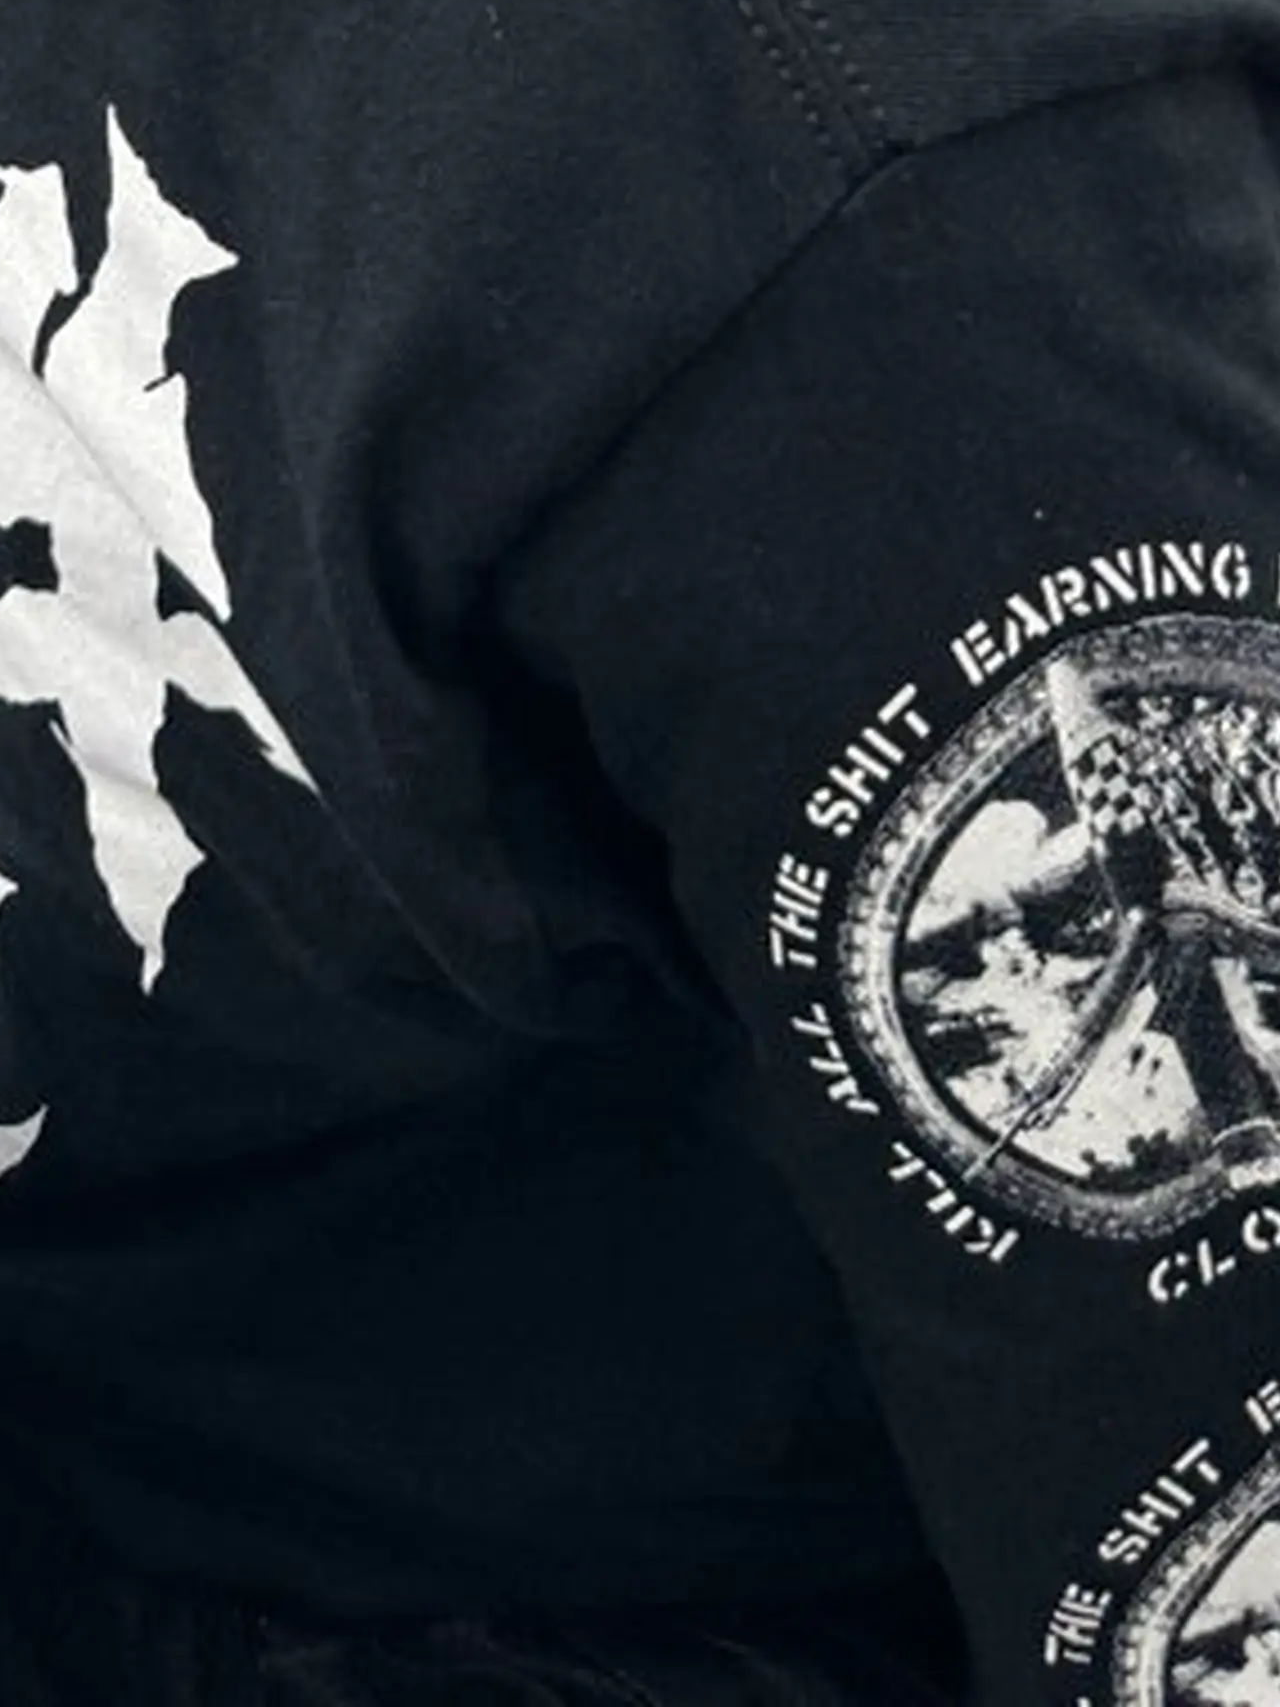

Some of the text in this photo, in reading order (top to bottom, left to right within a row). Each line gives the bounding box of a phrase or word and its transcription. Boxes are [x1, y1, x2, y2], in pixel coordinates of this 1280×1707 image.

[950, 541, 1250, 686] EARNING
[806, 683, 930, 837] SHIT
[770, 853, 829, 967] THE
[792, 1003, 880, 1115] ALL
[889, 1141, 1019, 1263] KILL
[1044, 1583, 1112, 1665] THE
[1098, 1438, 1220, 1564] SHIT
